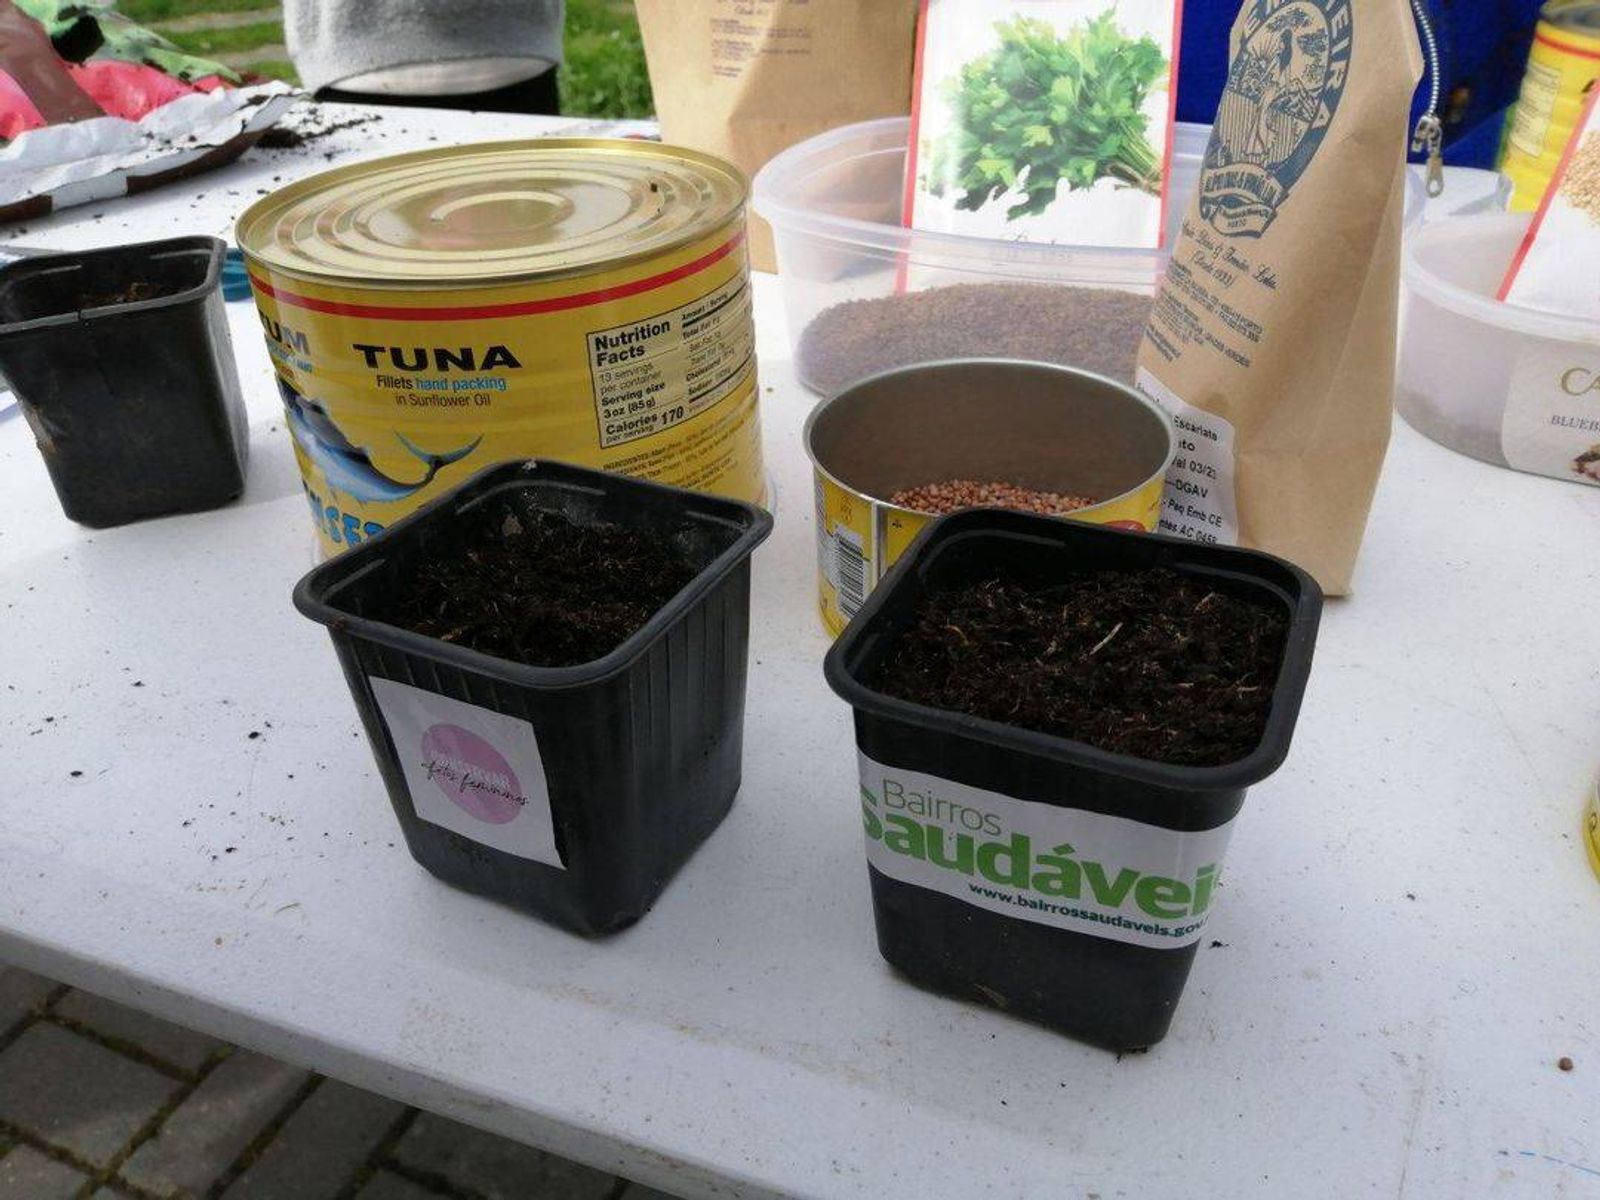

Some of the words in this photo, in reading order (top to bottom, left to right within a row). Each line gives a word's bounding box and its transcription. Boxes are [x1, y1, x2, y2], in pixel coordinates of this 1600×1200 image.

[595, 320, 671, 351] Nutrition
[352, 344, 523, 372] TUNA
[597, 345, 646, 366] Facts
[614, 362, 654, 380] servings
[376, 375, 414, 390] Fillets
[416, 378, 449, 391] hand
[452, 377, 507, 393] packing
[600, 381, 617, 395] per
[601, 388, 643, 407] Serving
[645, 381, 666, 395] size
[395, 394, 404, 406] in
[408, 394, 471, 408] Sunflower
[473, 393, 492, 406] Oil
[605, 414, 658, 435] Calories
[661, 406, 685, 425] 170
[1187, 505, 1207, 522] Emb
[1208, 513, 1223, 529] CE
[1179, 524, 1194, 538] AC
[882, 777, 1003, 837] Bairros
[860, 783, 1215, 920] Saudávei
